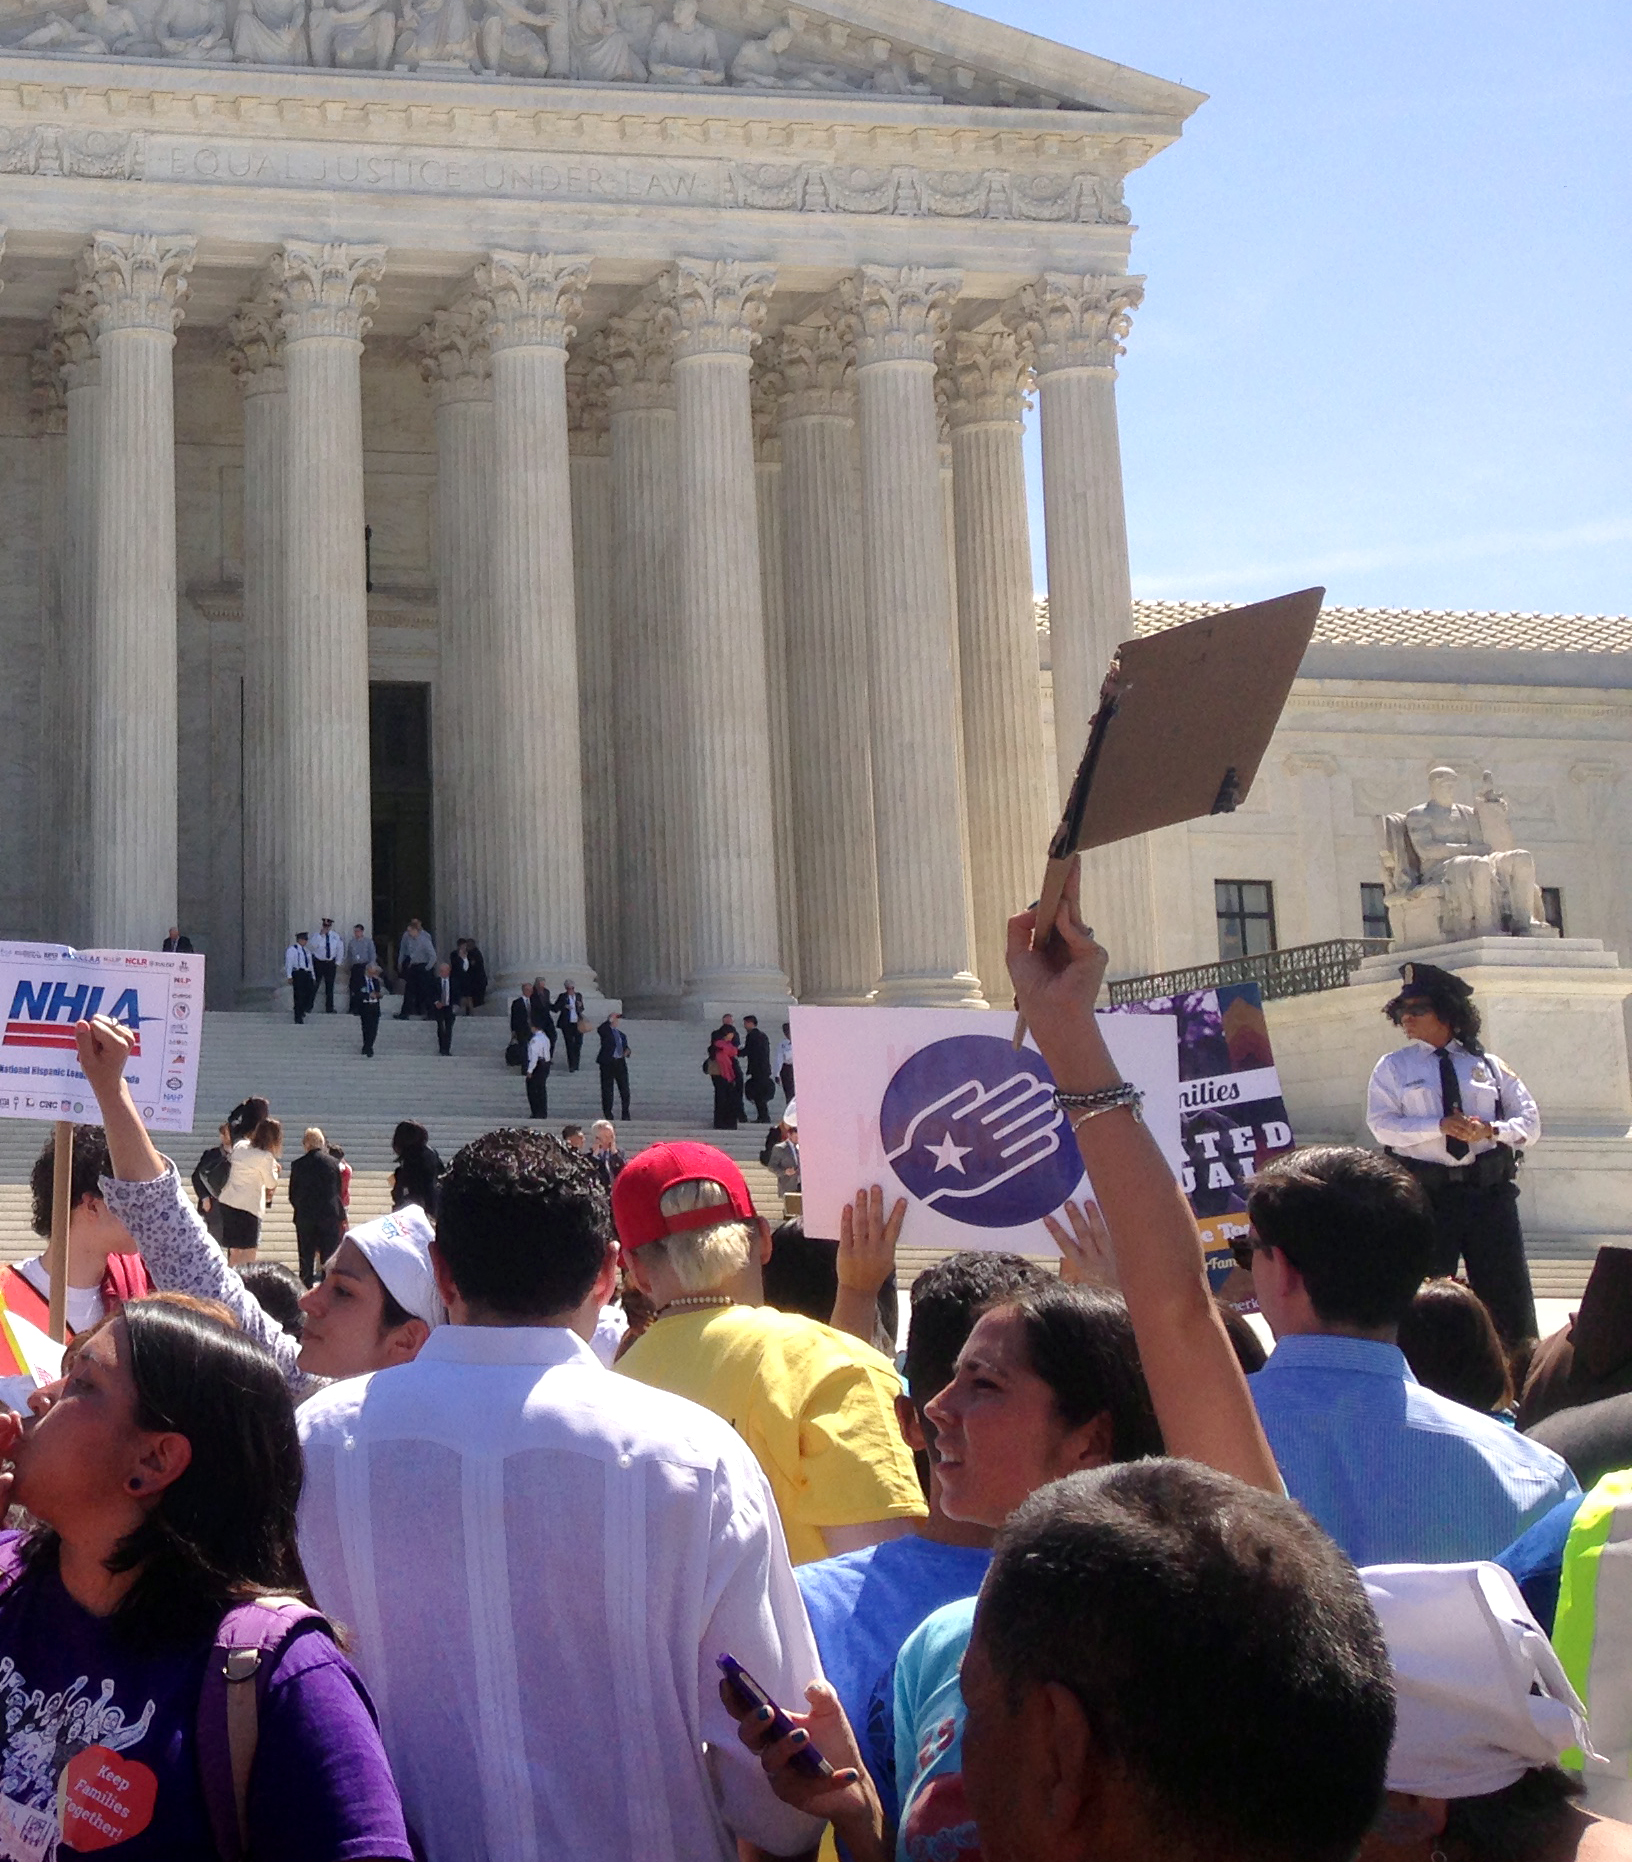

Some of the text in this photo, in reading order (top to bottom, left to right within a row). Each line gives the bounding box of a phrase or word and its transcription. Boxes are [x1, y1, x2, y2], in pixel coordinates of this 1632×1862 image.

[171, 148, 697, 196] EQUAL JUSTICE UNDER LAW
[125, 957, 147, 965] NCLR
[0, 1064, 30, 1075] National
[31, 1066, 65, 1077] Hispanic
[1185, 1121, 1291, 1161] TED
[97, 1765, 129, 1791] Keep
[74, 1779, 131, 1818] Families
[65, 1797, 123, 1841] Together!
